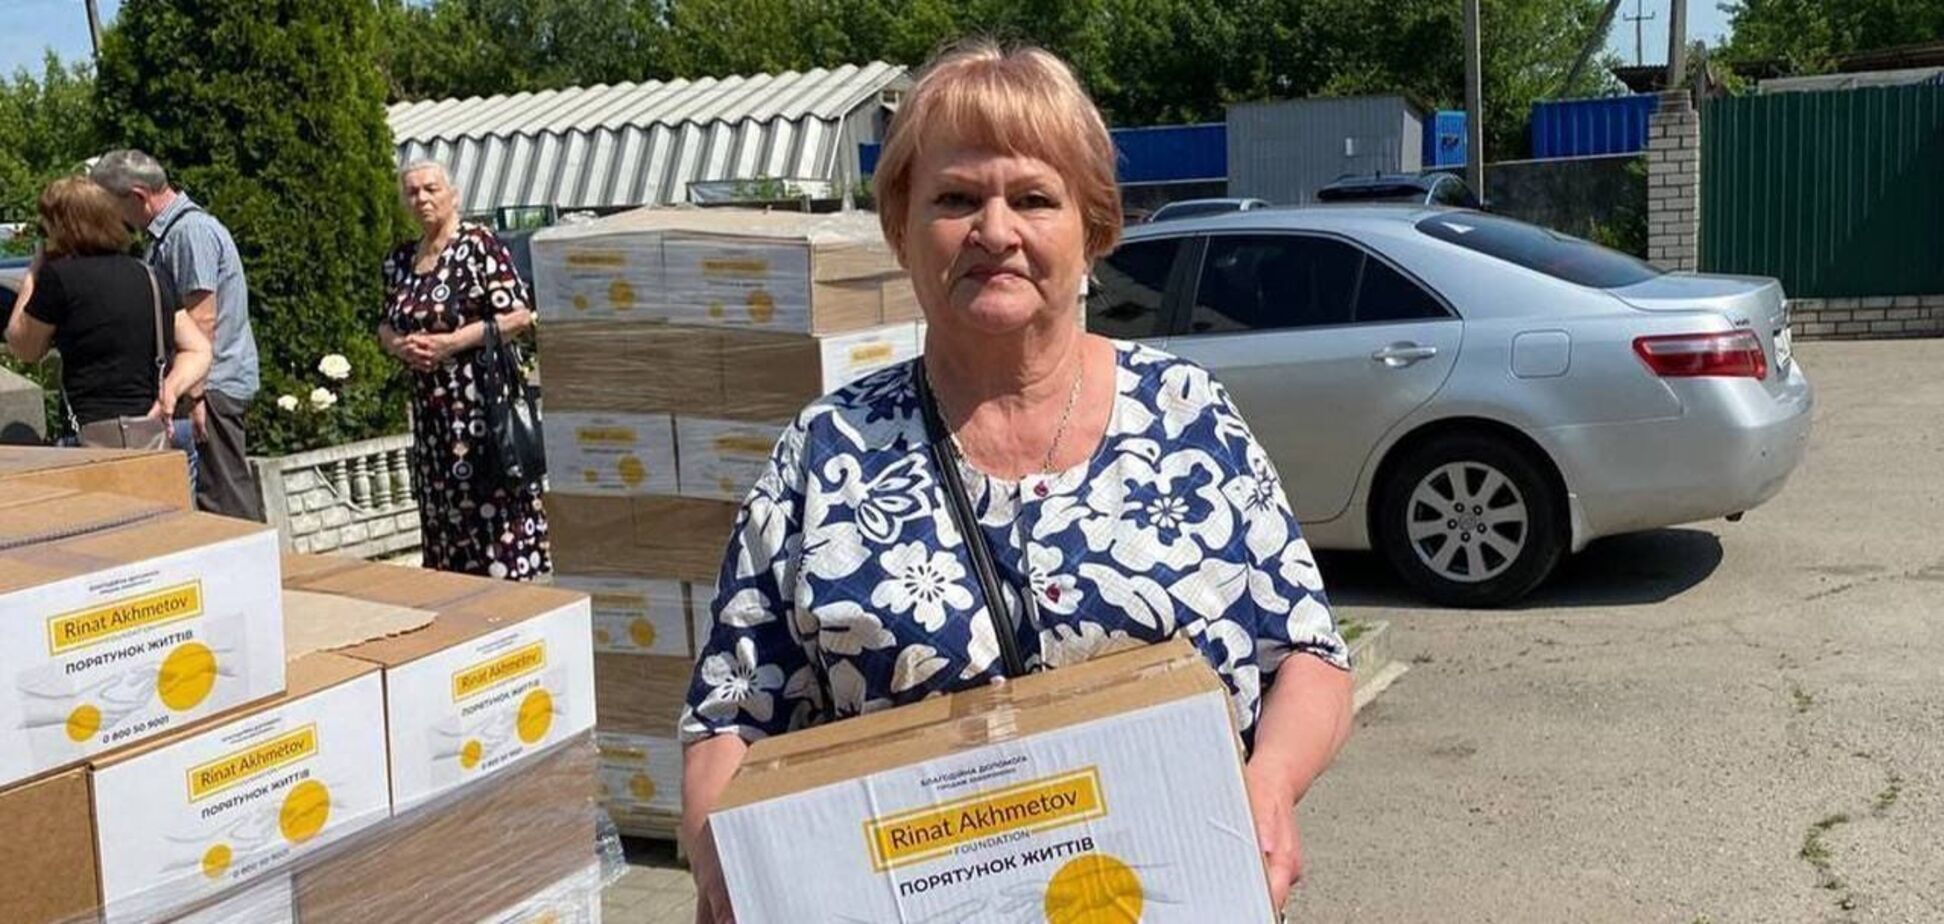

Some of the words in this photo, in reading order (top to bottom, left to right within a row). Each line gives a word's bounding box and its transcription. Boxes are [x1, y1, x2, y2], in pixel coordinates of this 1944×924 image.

[64, 615, 106, 639] Rinat
[111, 596, 188, 626] Akhmetov
[65, 643, 145, 674] ПОРЯТУНОК
[148, 630, 193, 652] ЖИТТІВ
[462, 671, 488, 689] Rinat
[103, 734, 110, 744] 0
[112, 727, 131, 741] 800
[133, 722, 146, 734] 50
[201, 765, 236, 787] Rinat
[240, 740, 305, 772] Akhmetov
[202, 786, 268, 819] ПОРЯТУНОК
[271, 768, 310, 792] ЖИТТІВ
[890, 821, 952, 850] Rinat
[959, 790, 1077, 833] Akhmetov
[954, 830, 1030, 855] FOUNDATION
[900, 855, 1017, 896] ПОРЯТУНОК
[1021, 836, 1095, 866] ЖИТТІВ
